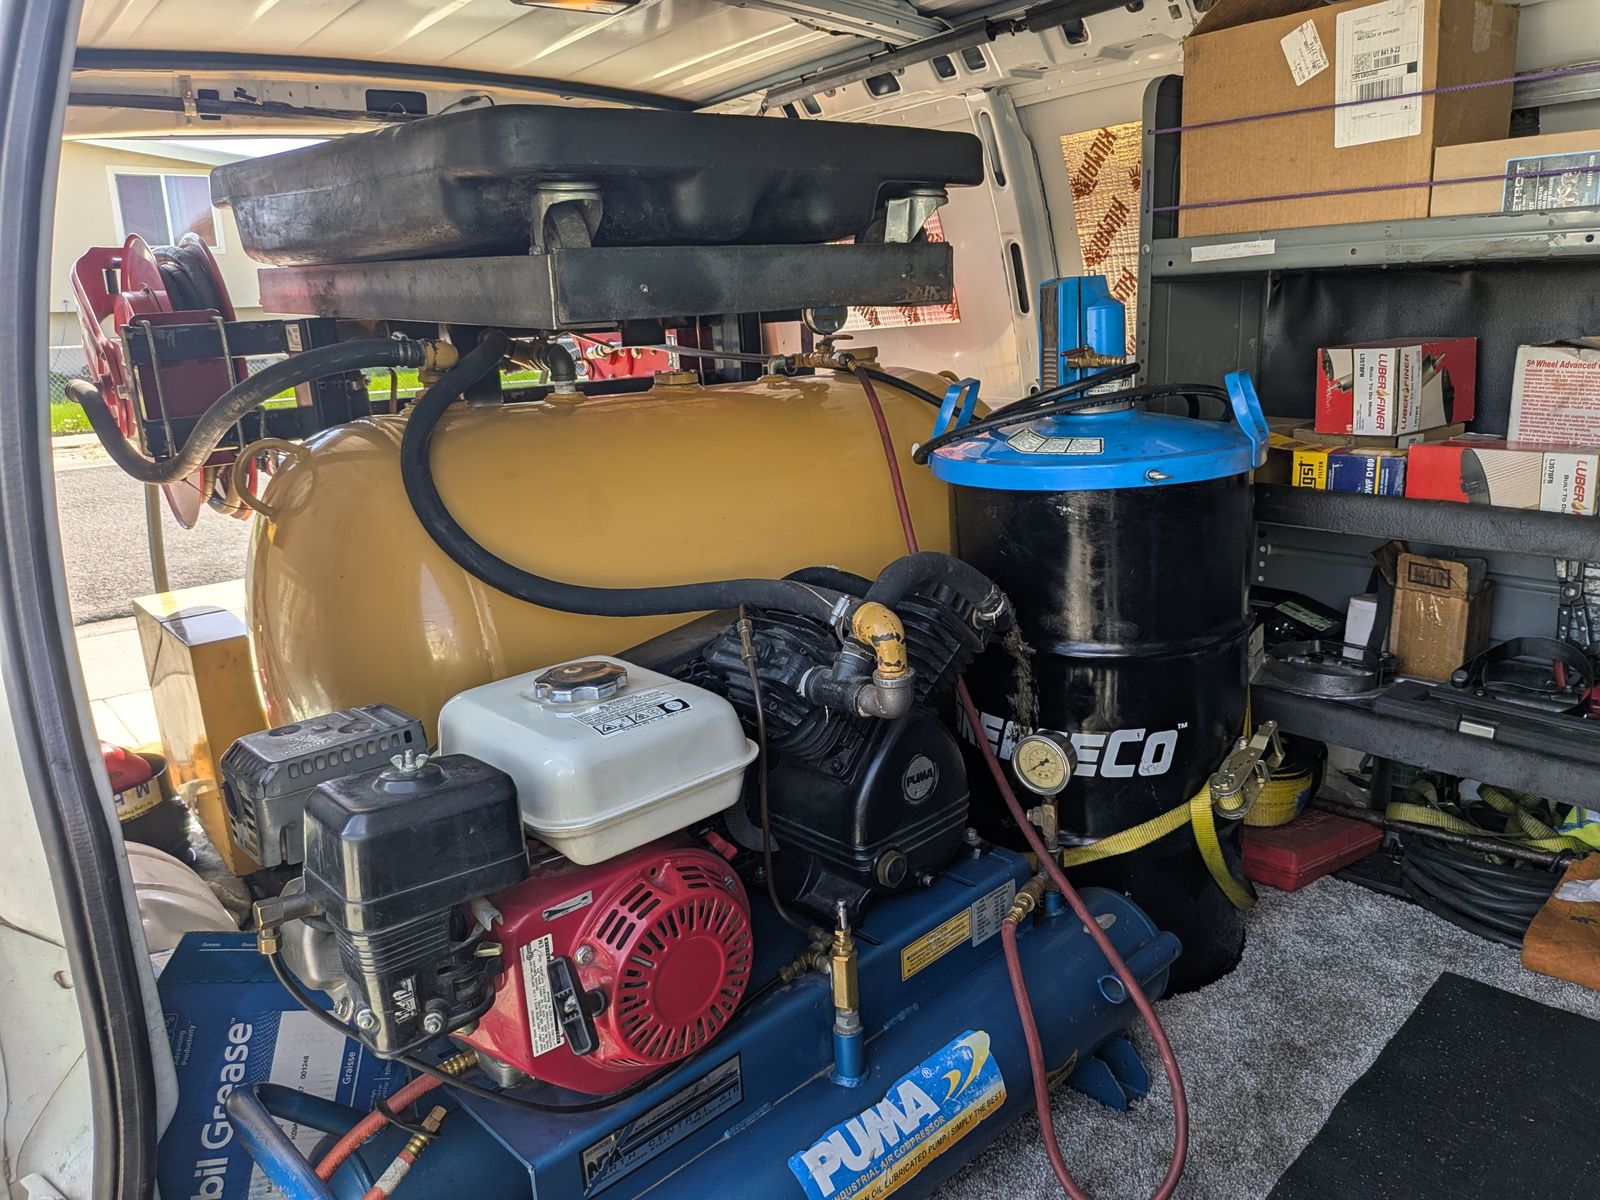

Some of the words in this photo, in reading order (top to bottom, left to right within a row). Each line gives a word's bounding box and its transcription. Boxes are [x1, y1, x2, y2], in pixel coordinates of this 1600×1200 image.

[1078, 127, 1117, 194] KILMAT
[1512, 161, 1525, 211] ETROT
[1094, 196, 1130, 262] KILMAT
[1377, 353, 1388, 392] LUBER
[1536, 360, 1558, 368] Wheel
[1560, 361, 1597, 369] Advanced
[1376, 397, 1387, 430] FINER
[1401, 395, 1409, 430] LUBER
[1366, 458, 1375, 478] D189
[1547, 458, 1556, 484] L3578FN
[1573, 460, 1588, 503] LUBER
[906, 768, 934, 787] PUMA
[927, 926, 948, 942] CAUTION
[201, 1022, 253, 1150] Grease
[301, 1055, 310, 1080] 001248
[343, 1051, 356, 1085] Graisse
[648, 1107, 708, 1148] CENTRAL
[719, 1085, 740, 1102] AIR
[801, 1079, 940, 1198] PUMA
[871, 1185, 885, 1198] OIL
[884, 1152, 928, 1188] LUBRICATED
[928, 1135, 947, 1154] PUMP
[950, 1114, 973, 1137] SIMPLY
[973, 1103, 987, 1119] THE
[986, 1091, 1003, 1111] BEST
[881, 1154, 894, 1170] AIR
[894, 1115, 945, 1159] COMPRESSOR
[190, 1157, 229, 1200] bil
